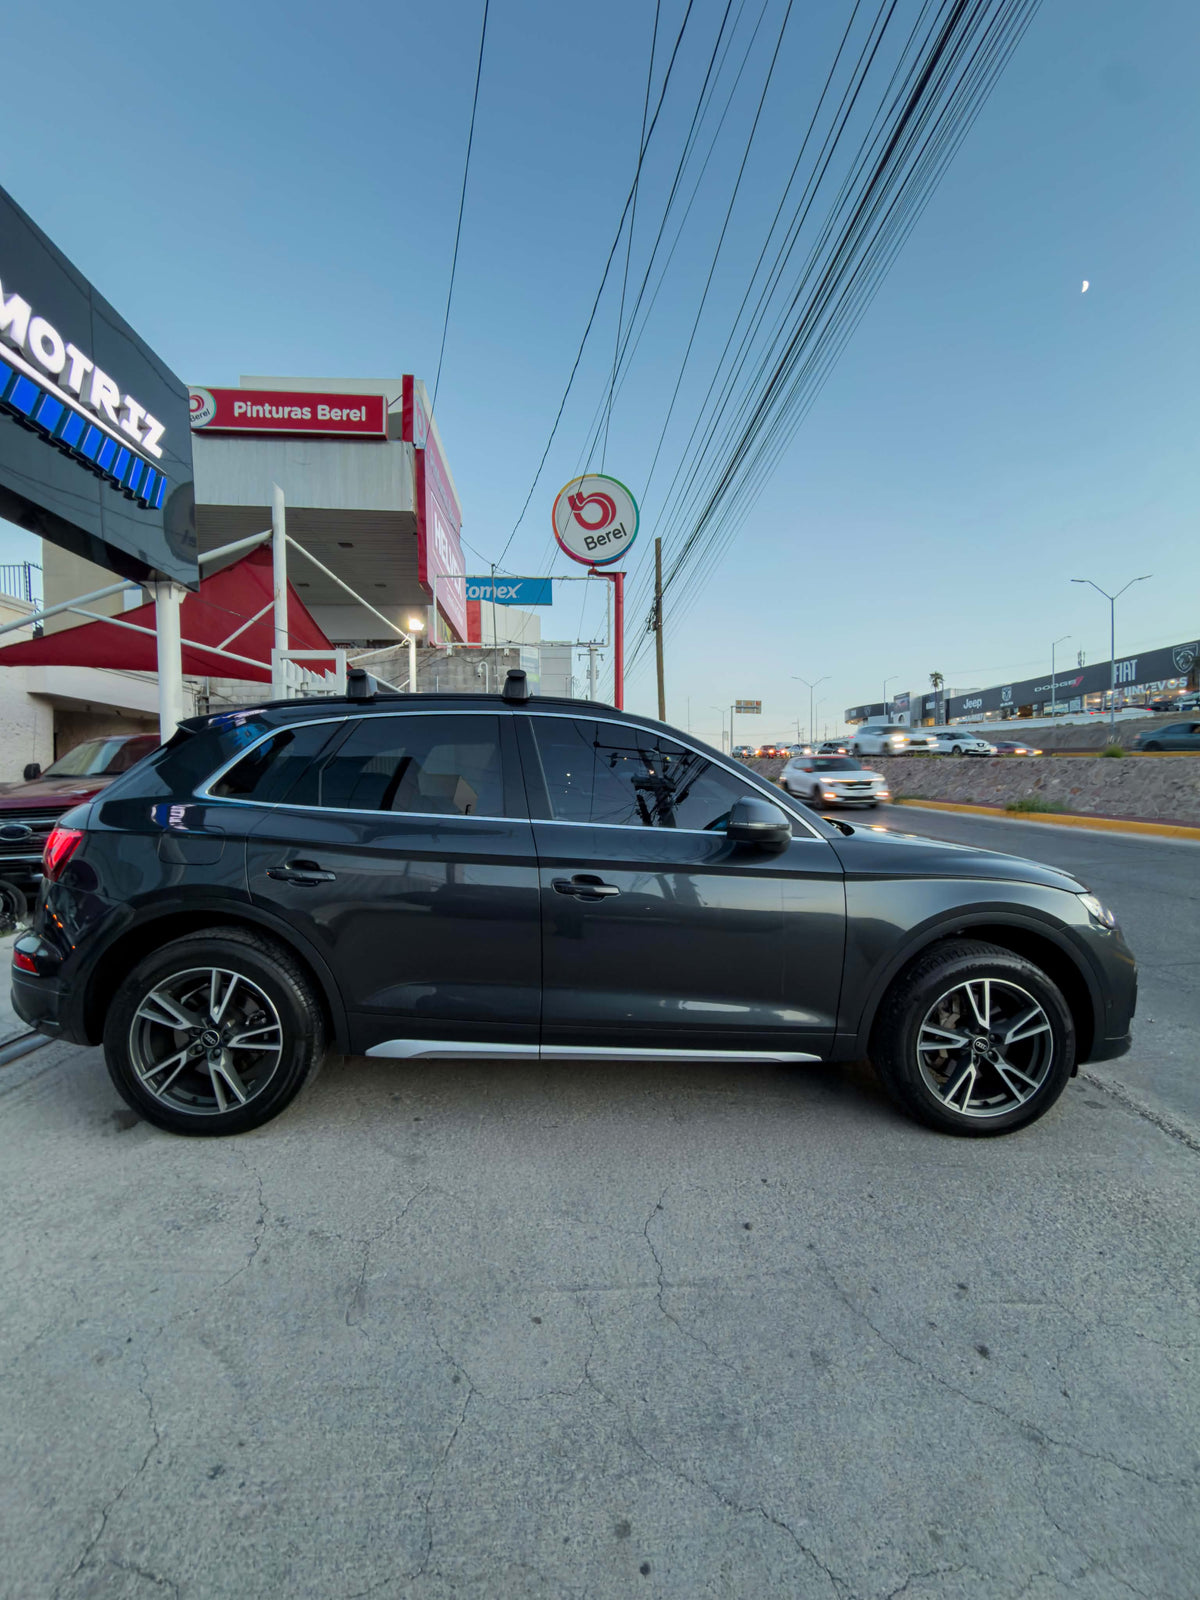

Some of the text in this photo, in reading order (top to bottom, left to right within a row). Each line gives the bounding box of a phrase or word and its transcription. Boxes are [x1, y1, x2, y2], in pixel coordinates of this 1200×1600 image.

[233, 401, 367, 422] Pinturas Berel
[584, 522, 628, 551] Berel
[1112, 658, 1138, 685] FIAT
[963, 698, 983, 710] Jeep
